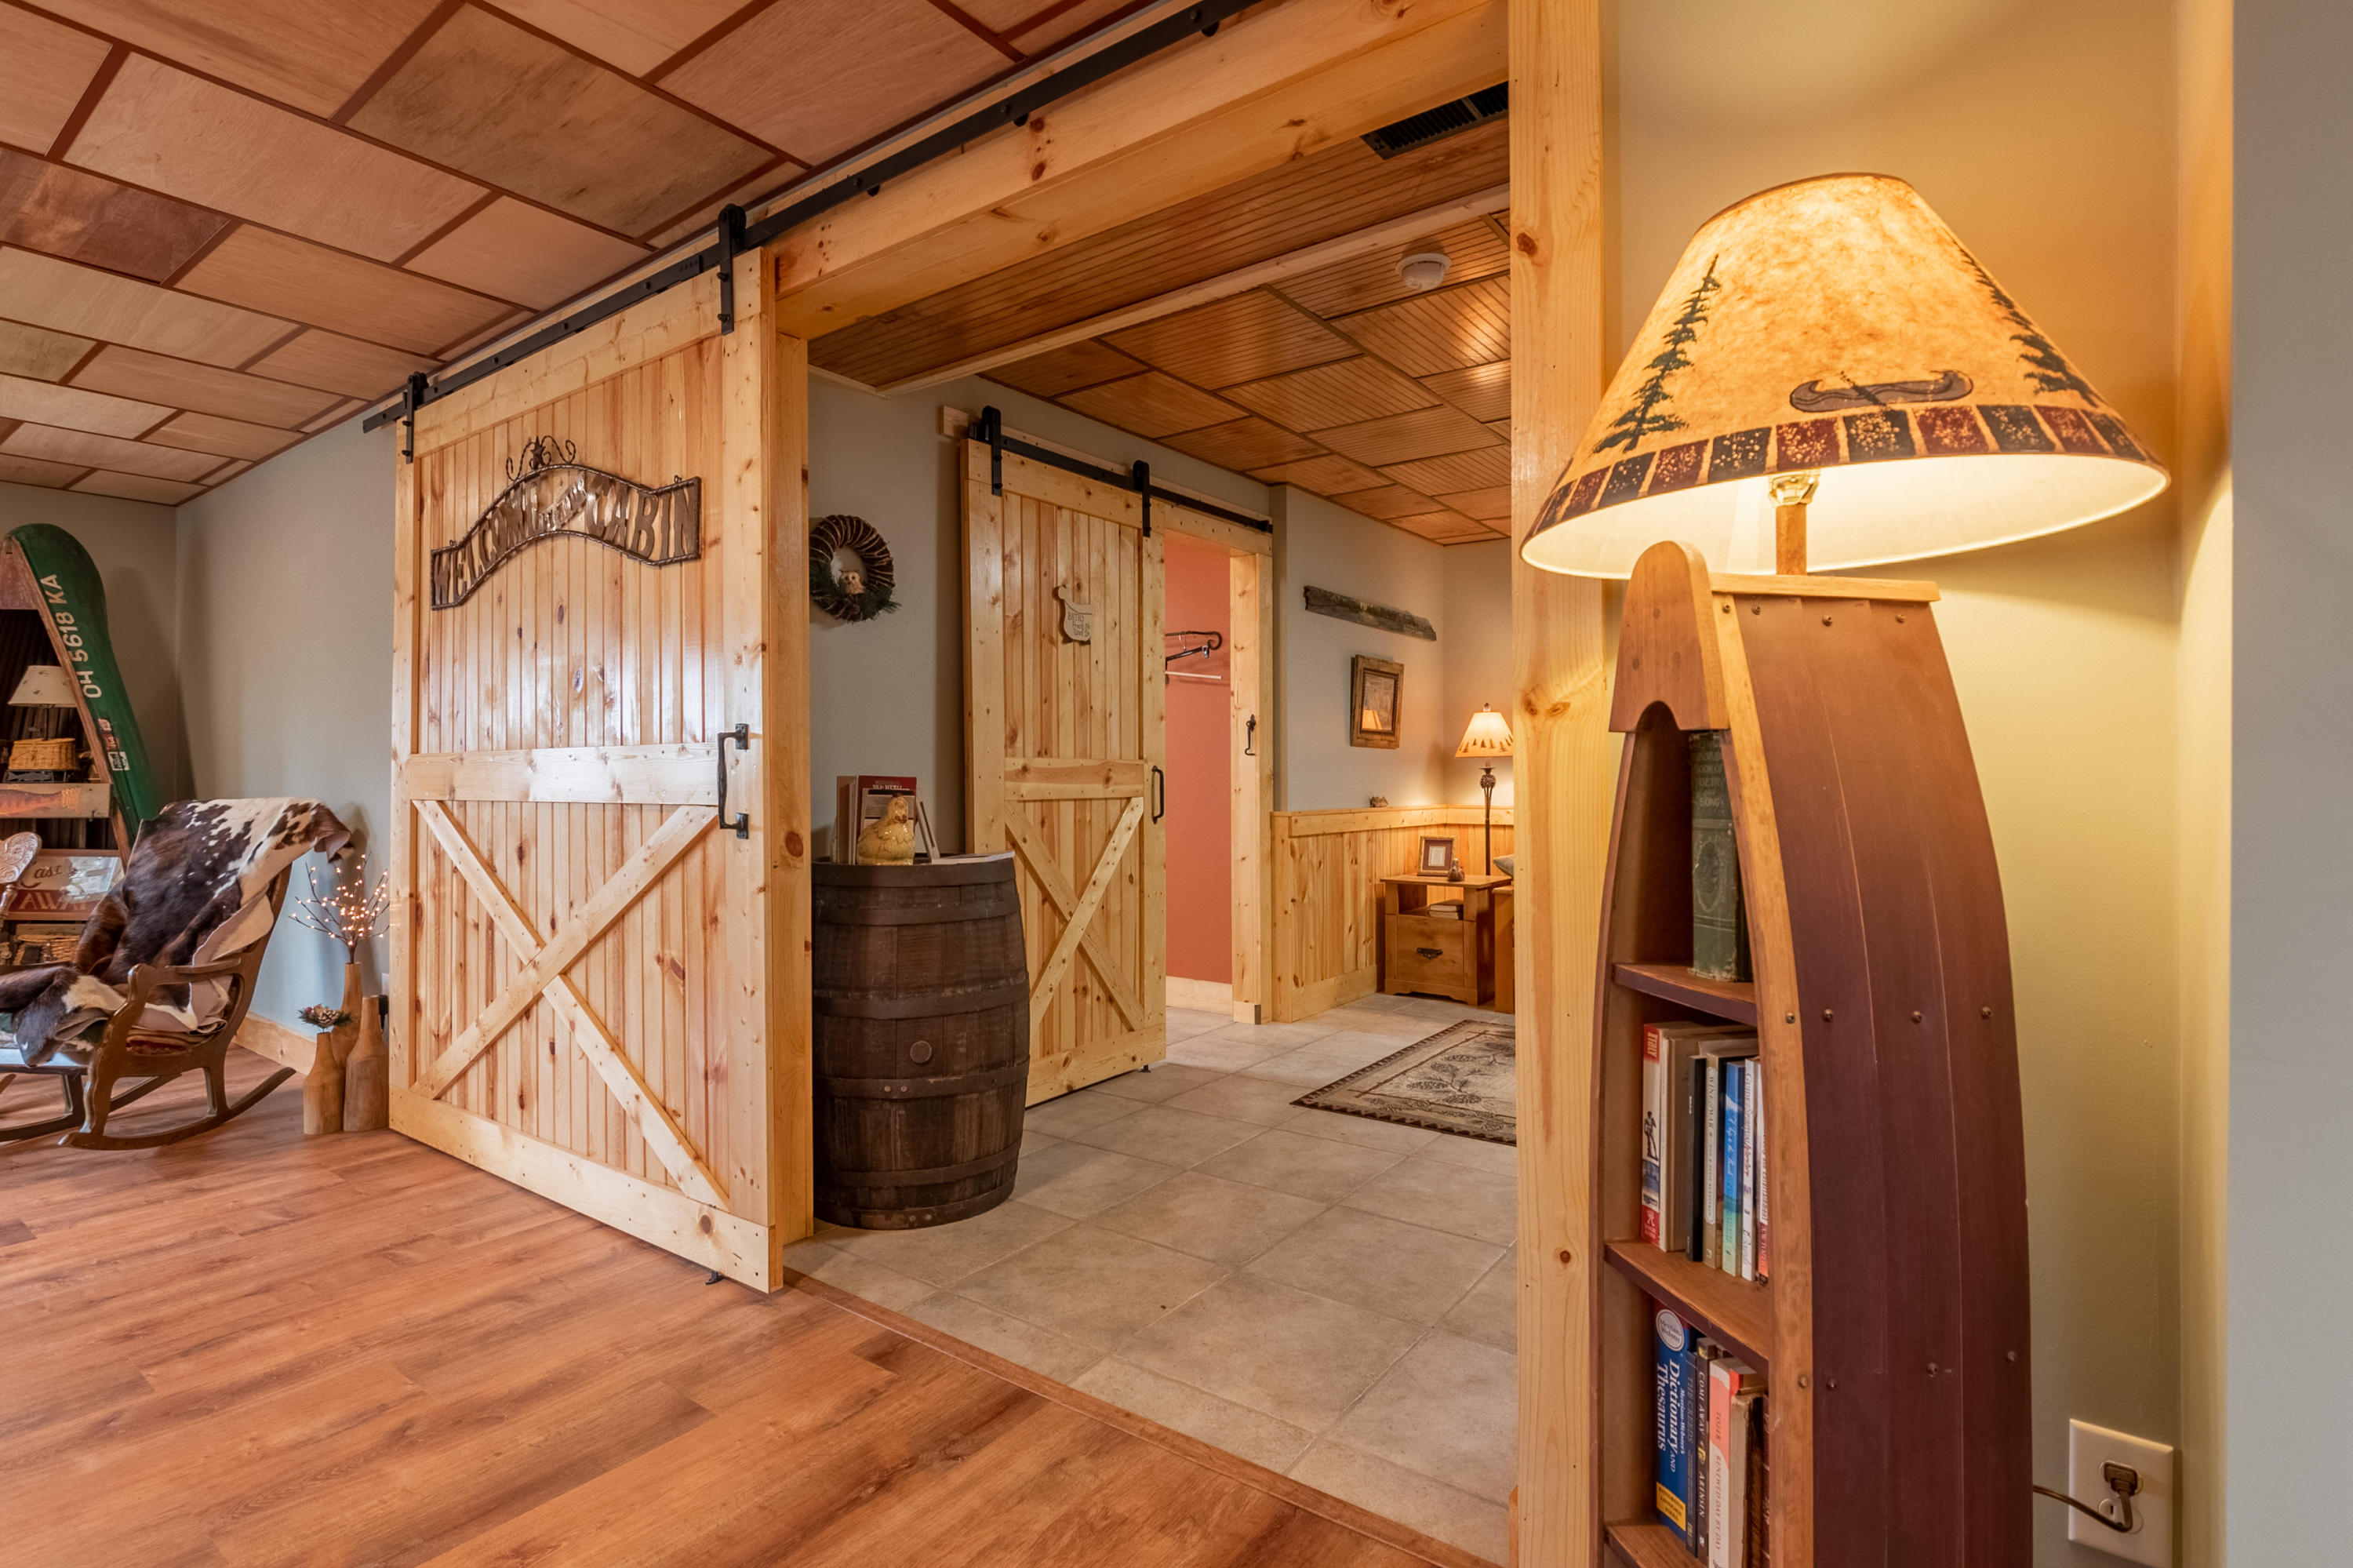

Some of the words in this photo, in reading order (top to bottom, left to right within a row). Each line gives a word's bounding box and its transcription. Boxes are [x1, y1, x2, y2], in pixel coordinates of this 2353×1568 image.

[433, 475, 541, 606] WELCOME
[587, 474, 697, 562] CABIN
[40, 574, 67, 605] KA
[55, 611, 89, 662] 5618
[76, 671, 102, 698] OH
[1657, 1363, 1669, 1451] Thesaurus
[1667, 1359, 1681, 1454] Dictionary
